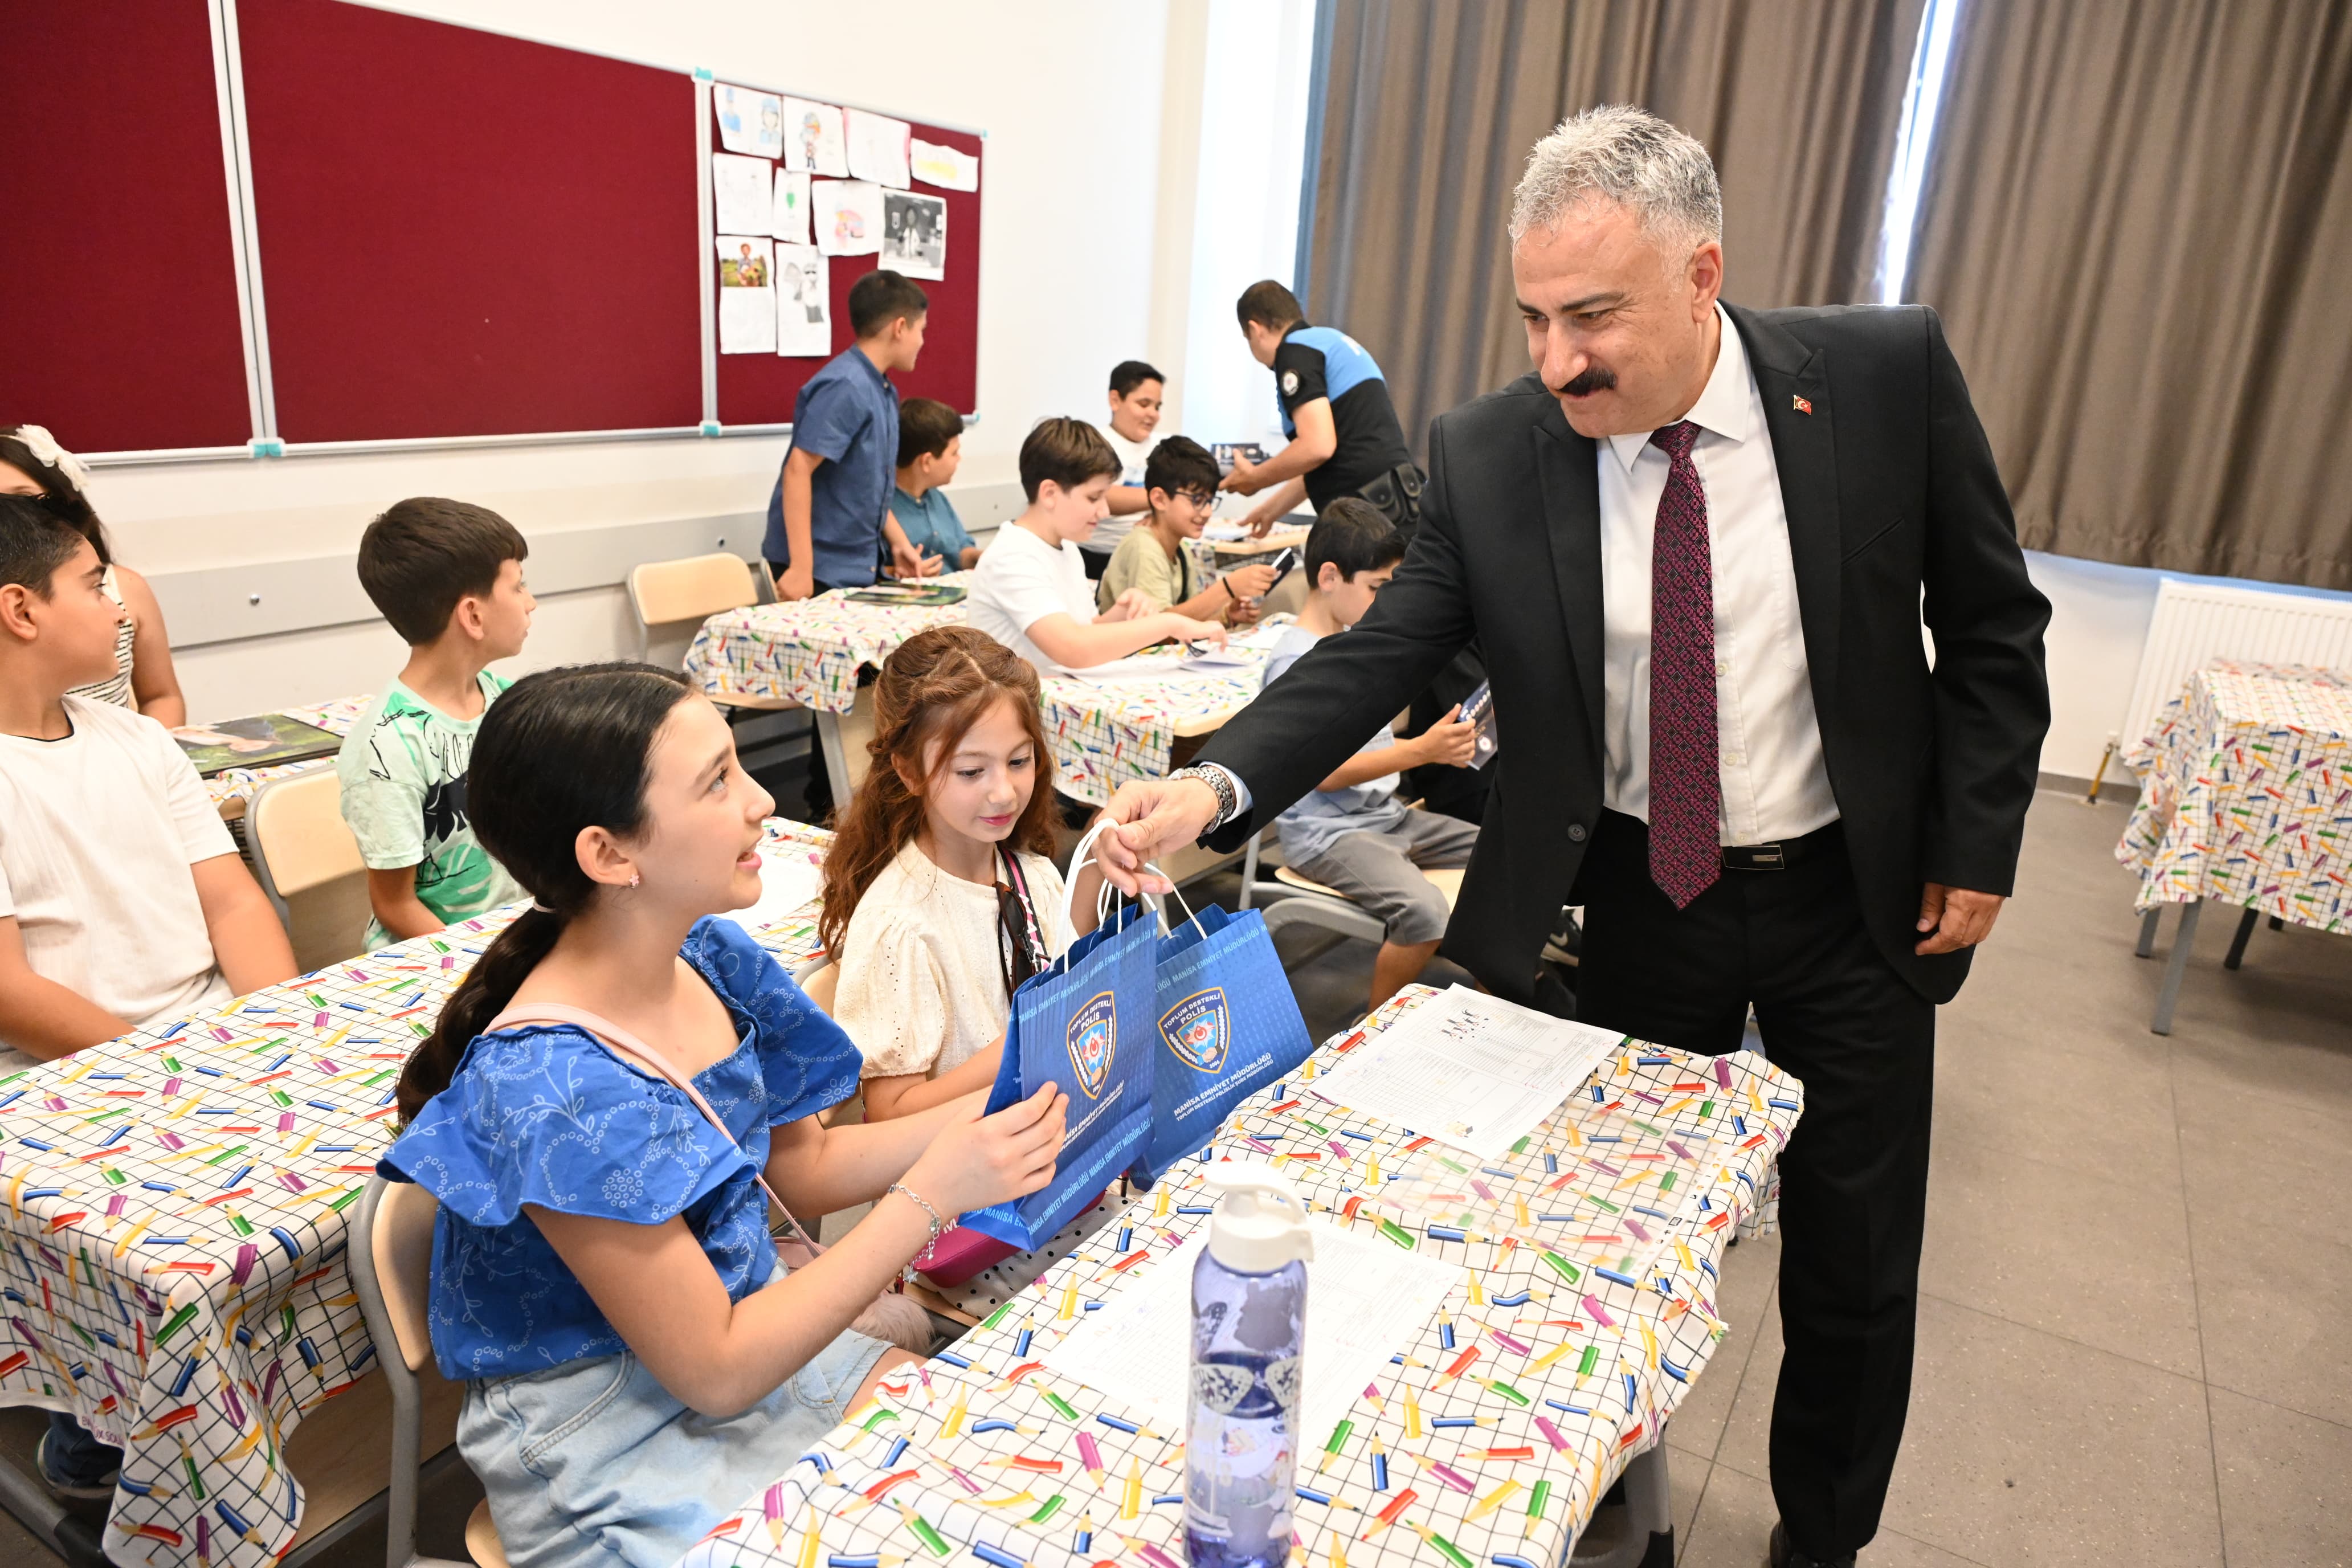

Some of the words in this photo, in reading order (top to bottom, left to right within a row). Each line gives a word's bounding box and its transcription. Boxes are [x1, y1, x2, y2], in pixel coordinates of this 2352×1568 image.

[1172, 965, 1197, 983] MANİSA
[1197, 950, 1223, 969] EMNİYET
[1223, 927, 1259, 954] MÜDÜRLÜĞÜ
[1038, 992, 1060, 1012] EMNİYET
[1104, 948, 1126, 966] EMNİYET
[1070, 1011, 1089, 1034] TOPLUM
[1089, 998, 1111, 1014] DESTEKLİ
[1081, 1011, 1100, 1032] POLİS
[1163, 1007, 1189, 1029] TOPLUM
[1189, 993, 1220, 1010] DESTEKLİ
[1180, 1005, 1206, 1024] POLİS
[1209, 1059, 1220, 1069] 2006
[1173, 1097, 1200, 1116] MANİSA
[1200, 1077, 1230, 1100] EMNİYET
[1230, 1052, 1272, 1083] MÜDÜRLÜĞÜ
[1176, 1106, 1195, 1122] TOPLUM
[1194, 1095, 1216, 1110] DESTEKLİ
[1215, 1083, 1235, 1098] POLİSLİK
[1043, 1197, 1062, 1222] EMNİYET
[1061, 1171, 1089, 1203] MÜDÜRLÜĞÜ
[1089, 1157, 1106, 1178] MANİSA
[1105, 1141, 1123, 1163] EMNİYET
[1122, 1117, 1150, 1147] MÜDÜRLÜĞÜ
[984, 1207, 1012, 1224] MANİSA
